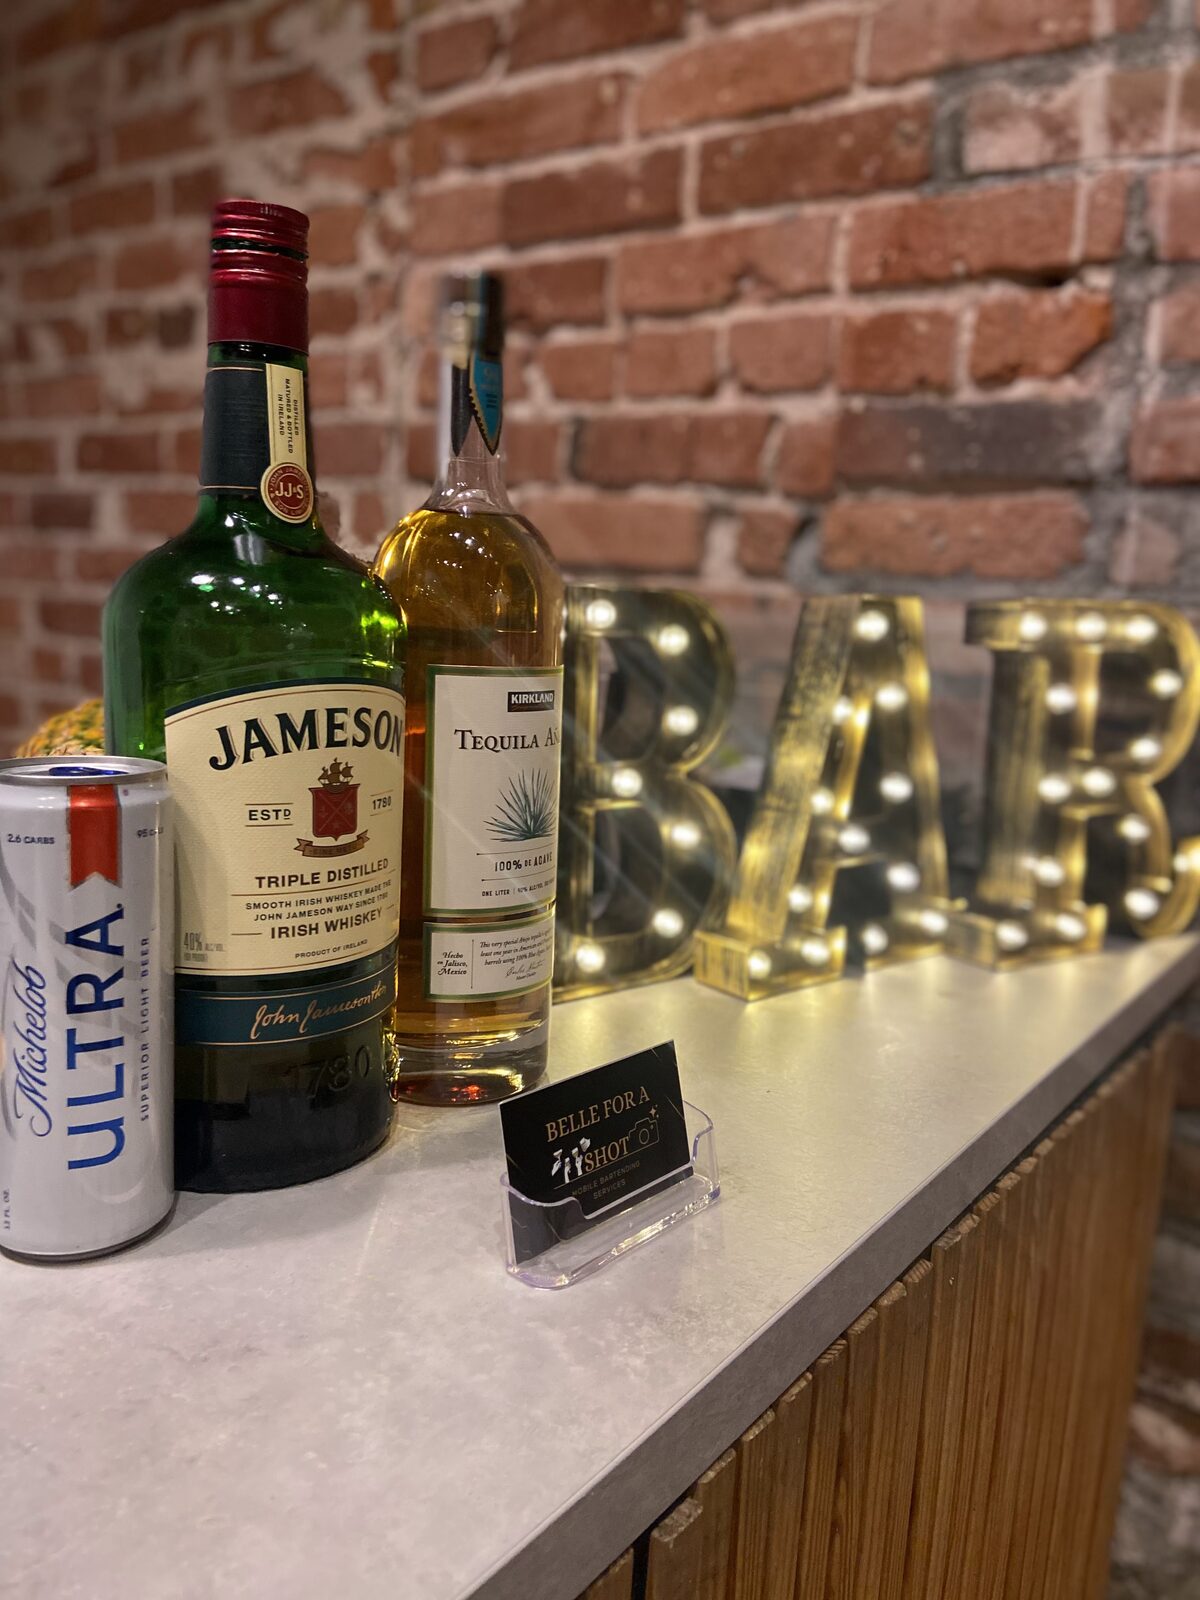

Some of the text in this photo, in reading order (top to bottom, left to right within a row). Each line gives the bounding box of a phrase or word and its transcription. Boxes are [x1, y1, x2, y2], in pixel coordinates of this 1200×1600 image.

[511, 692, 554, 704] KIRKLAND
[209, 707, 402, 771] JAMESON
[454, 729, 539, 752] TEQUILA
[372, 796, 391, 810] 1780
[552, 584, 1200, 1001] BAR
[24, 836, 55, 845] CARBS
[255, 858, 389, 889] TRIPLE DISTILLED
[495, 859, 522, 872] 100%
[524, 859, 532, 867] DE
[245, 901, 292, 910] SMOOTH
[295, 897, 323, 907] IRISH
[325, 889, 363, 903] WHISKEY
[364, 885, 382, 895] MADE
[254, 913, 283, 922] JOHN
[286, 908, 333, 920] JAMESON
[336, 903, 353, 913] WAY
[355, 898, 376, 909] SINCE
[271, 907, 383, 939] IRISH WHISKEY
[295, 948, 330, 959] PRODUCT
[343, 939, 368, 951] IRELAND
[140, 937, 149, 1122] SUPERIOR LIGHT BEER
[250, 1004, 299, 1040] John
[13, 955, 52, 1137] Michelob
[65, 907, 125, 1170] ULTRA
[544, 1086, 650, 1142] BELLE FOR A
[584, 1136, 630, 1172] SHOT
[572, 1160, 640, 1196] MOBILE BARTENDING
[593, 1180, 626, 1200] SERVICES
